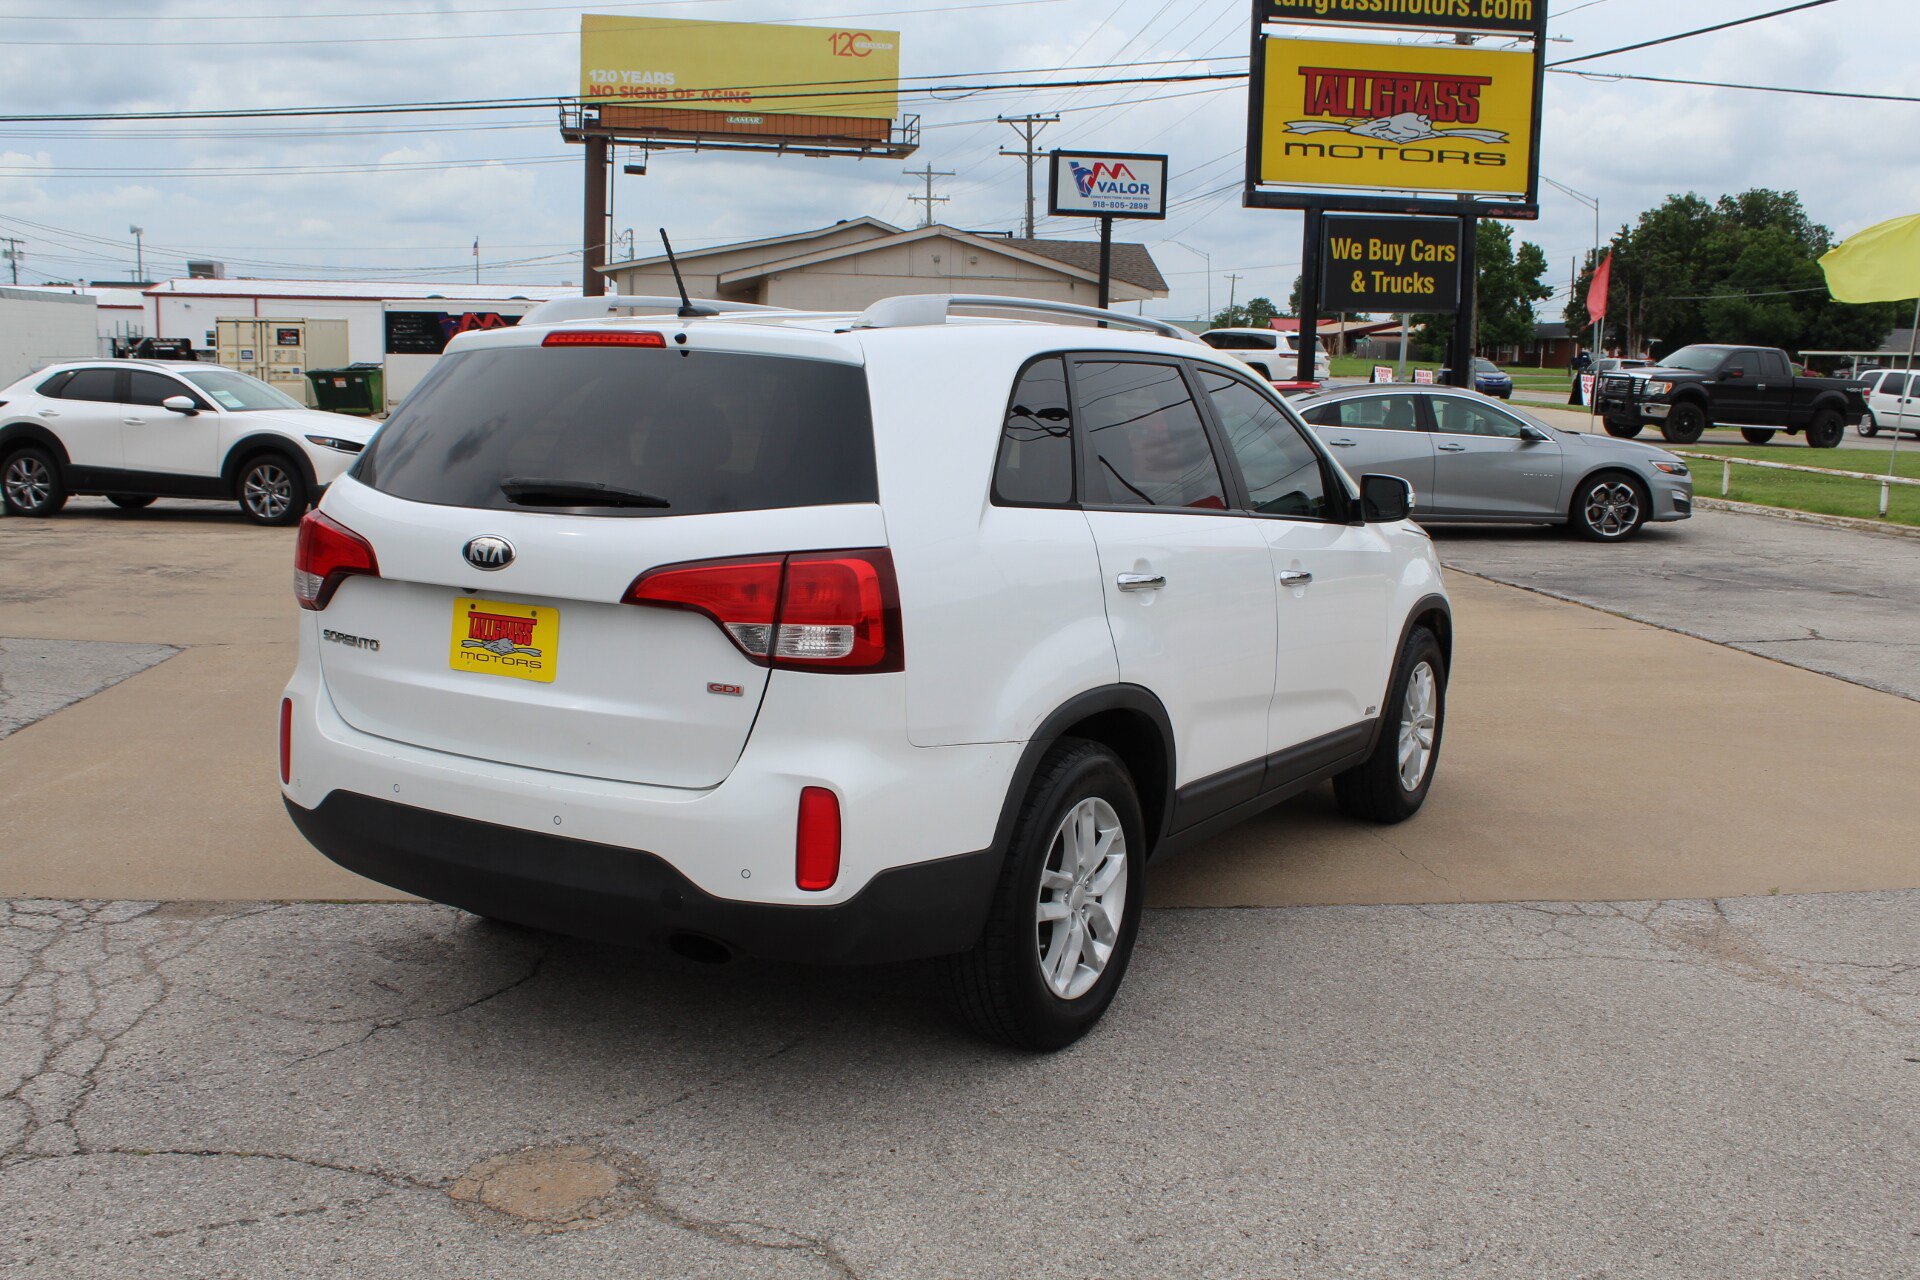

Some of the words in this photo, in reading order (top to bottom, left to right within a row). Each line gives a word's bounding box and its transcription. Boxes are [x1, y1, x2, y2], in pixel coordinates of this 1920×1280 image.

[590, 69, 618, 83] 120
[620, 71, 675, 85] YEARS
[590, 85, 615, 97] NO
[619, 85, 669, 99] SIGNS
[672, 88, 696, 99] OF
[701, 89, 752, 104] AGING
[1298, 66, 1492, 124] TALLGRASS
[1097, 181, 1150, 195] VALOR
[1330, 237, 1362, 260] We
[1368, 238, 1406, 266] Buy
[1411, 239, 1456, 262] Cars
[1351, 270, 1366, 293] &
[1371, 271, 1435, 294] Trucks
[469, 541, 504, 563] KIA
[468, 611, 537, 646] TALLGRASS
[323, 629, 380, 651] SORENTO
[709, 683, 740, 695] GDI
